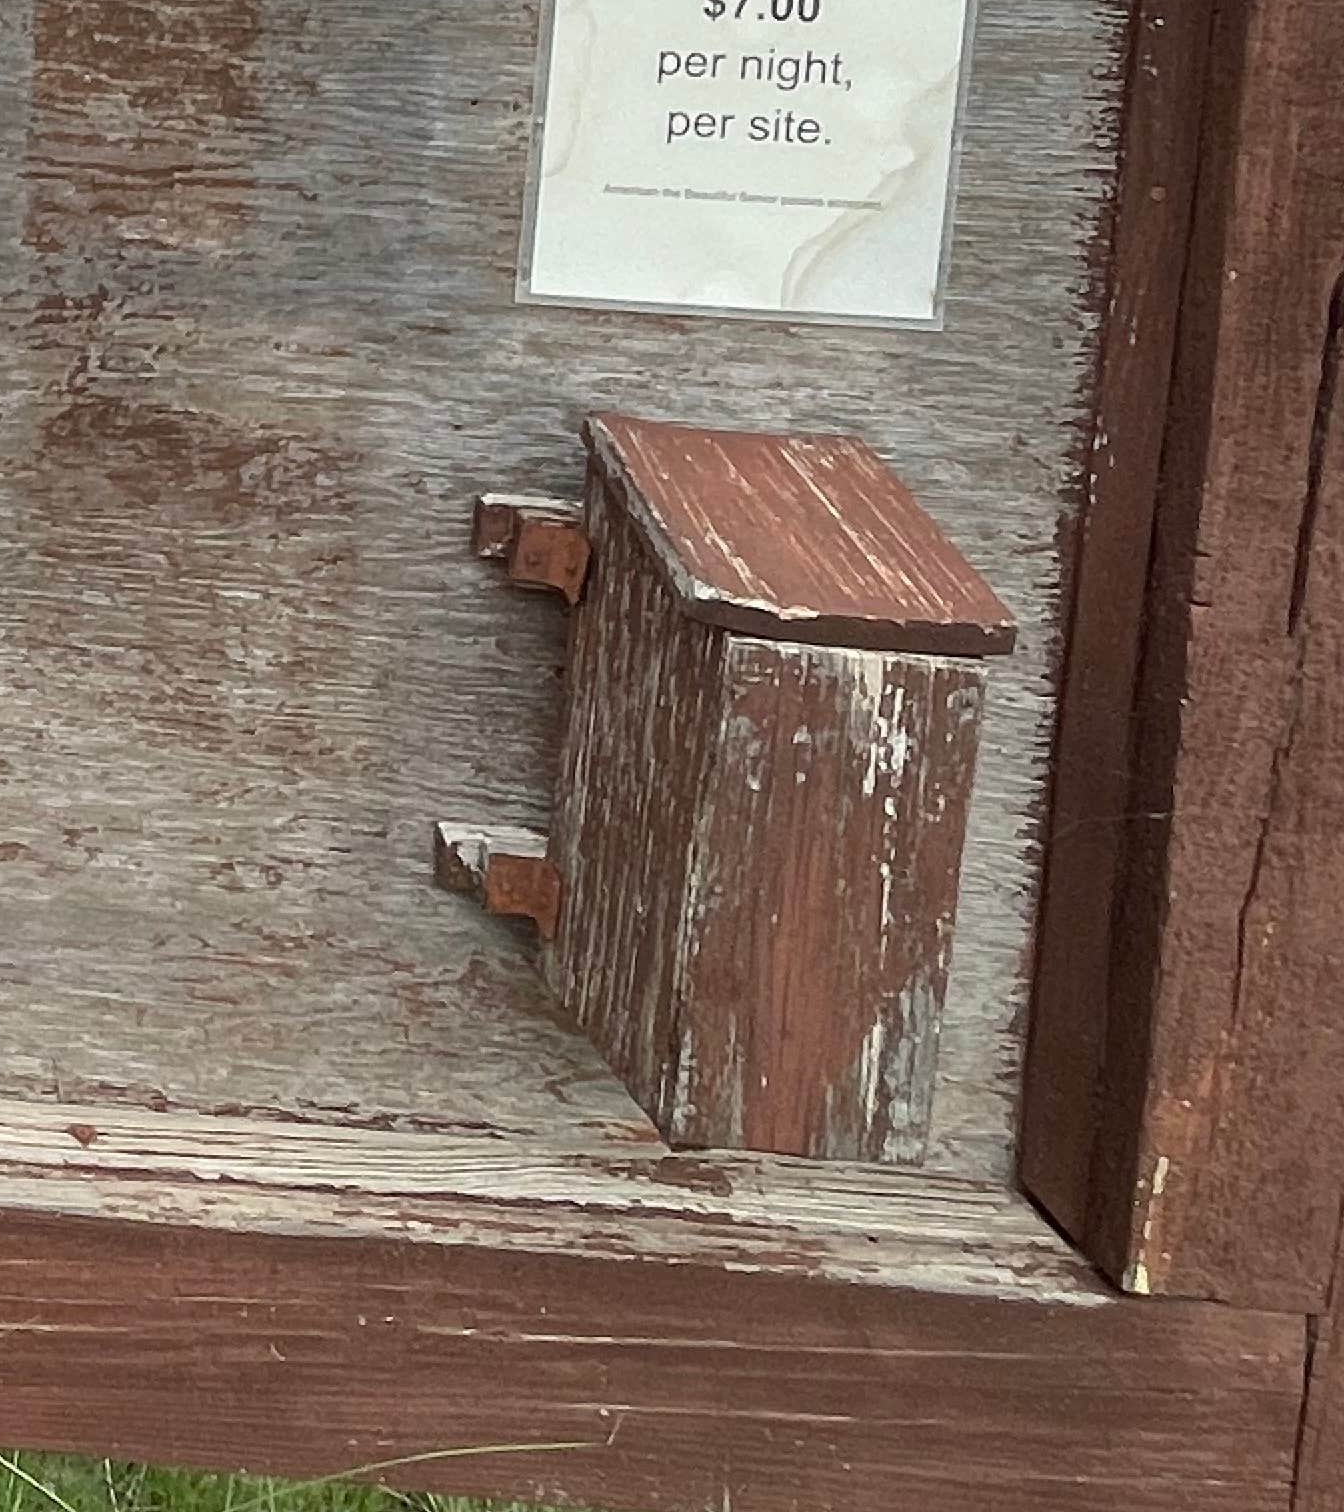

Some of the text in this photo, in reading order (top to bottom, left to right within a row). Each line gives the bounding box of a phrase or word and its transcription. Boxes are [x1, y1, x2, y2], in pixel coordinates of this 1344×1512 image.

[657, 48, 853, 91] per night,
[666, 109, 833, 145] per site.
